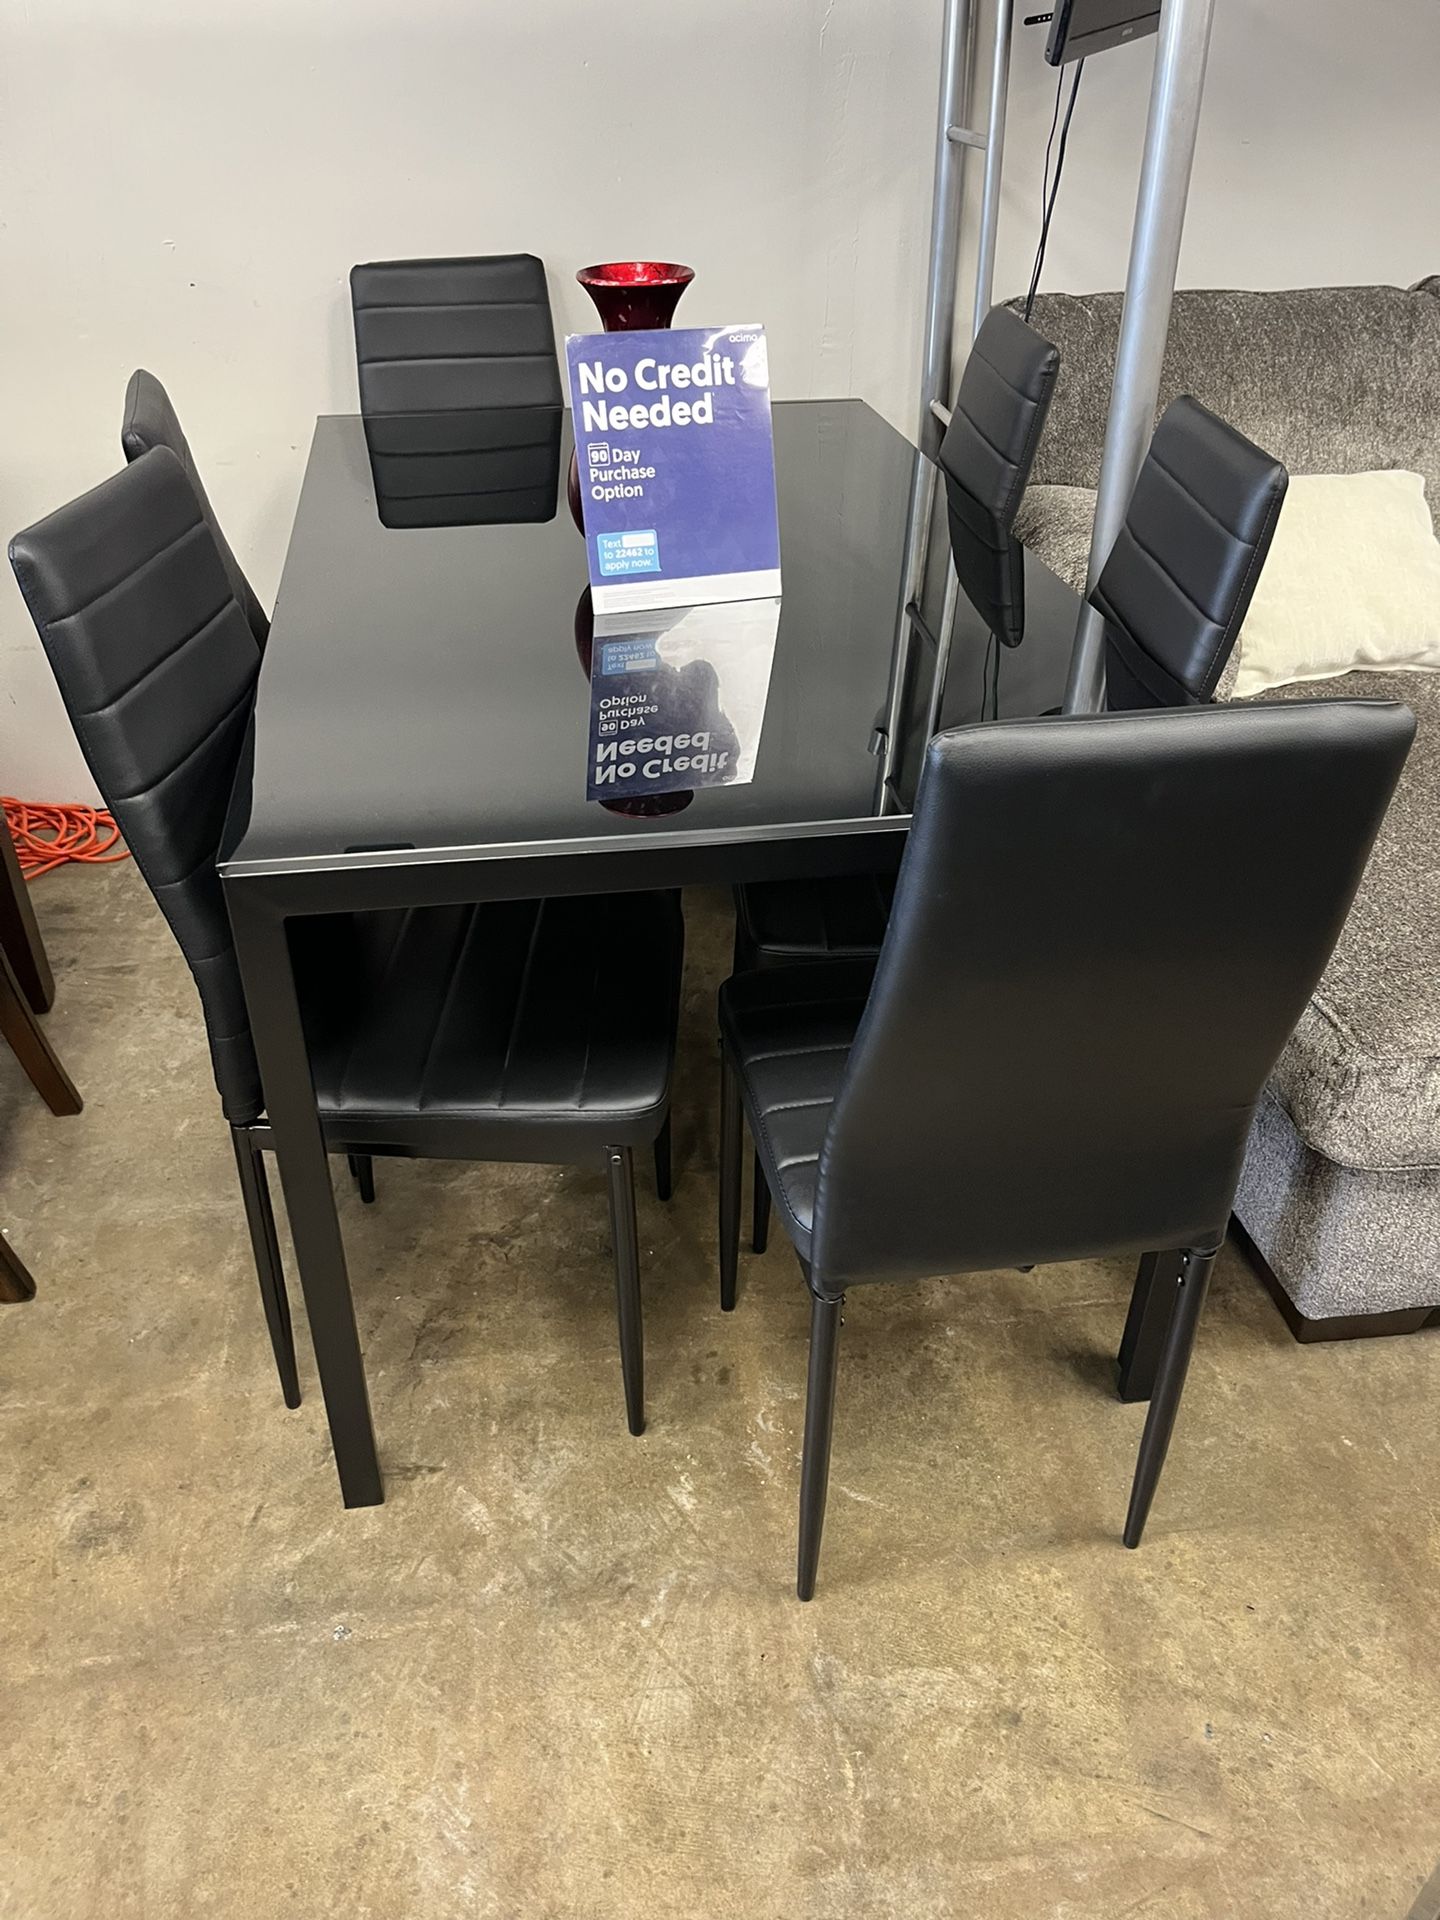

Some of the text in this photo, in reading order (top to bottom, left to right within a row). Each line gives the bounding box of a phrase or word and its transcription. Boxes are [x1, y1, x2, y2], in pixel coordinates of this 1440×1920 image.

[578, 353, 736, 394] No Credit
[582, 392, 713, 432] Needed
[591, 448, 640, 464] 90 Day
[589, 465, 656, 482] Purchase
[591, 483, 643, 502] Option
[602, 540, 622, 549] Text
[603, 551, 613, 559] to
[644, 547, 654, 556] to
[605, 560, 630, 571] apply
